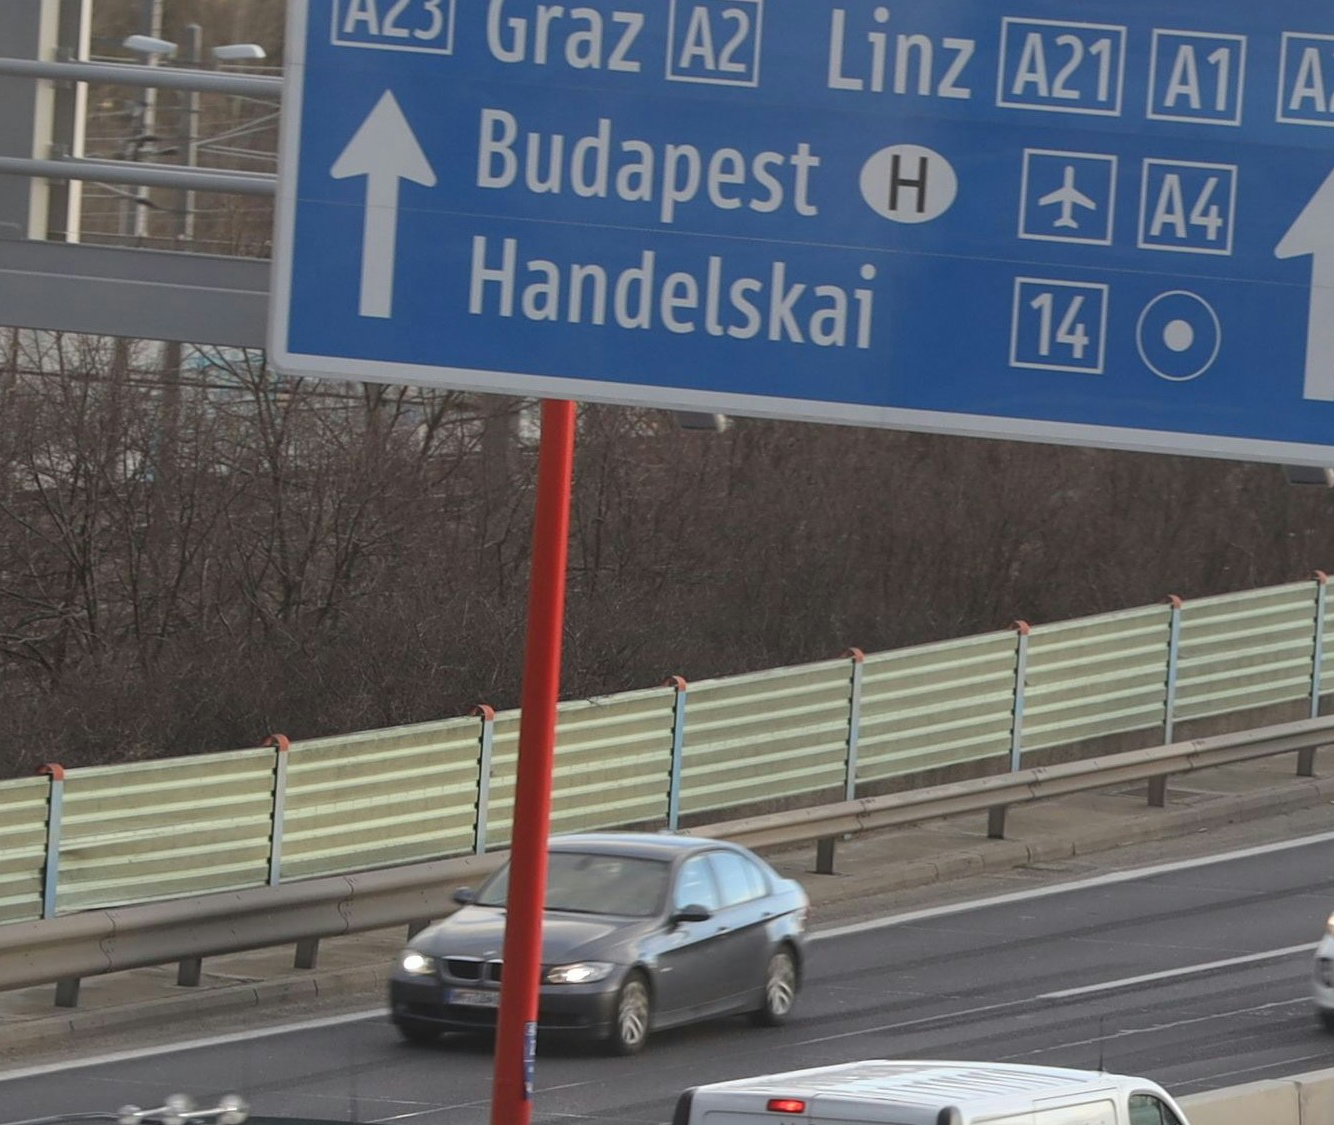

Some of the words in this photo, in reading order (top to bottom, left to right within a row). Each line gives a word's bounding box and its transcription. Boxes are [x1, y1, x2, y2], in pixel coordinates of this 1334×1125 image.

[488, 0, 643, 72] Graz
[680, 6, 749, 72] A2
[829, 7, 974, 98] Linz
[1013, 33, 1110, 101] A21
[1165, 45, 1229, 111] A1
[479, 109, 819, 223] Budapest
[888, 154, 929, 214] H
[1151, 174, 1222, 240] A4
[471, 236, 875, 348] Handelskai
[1032, 293, 1088, 358] 14
